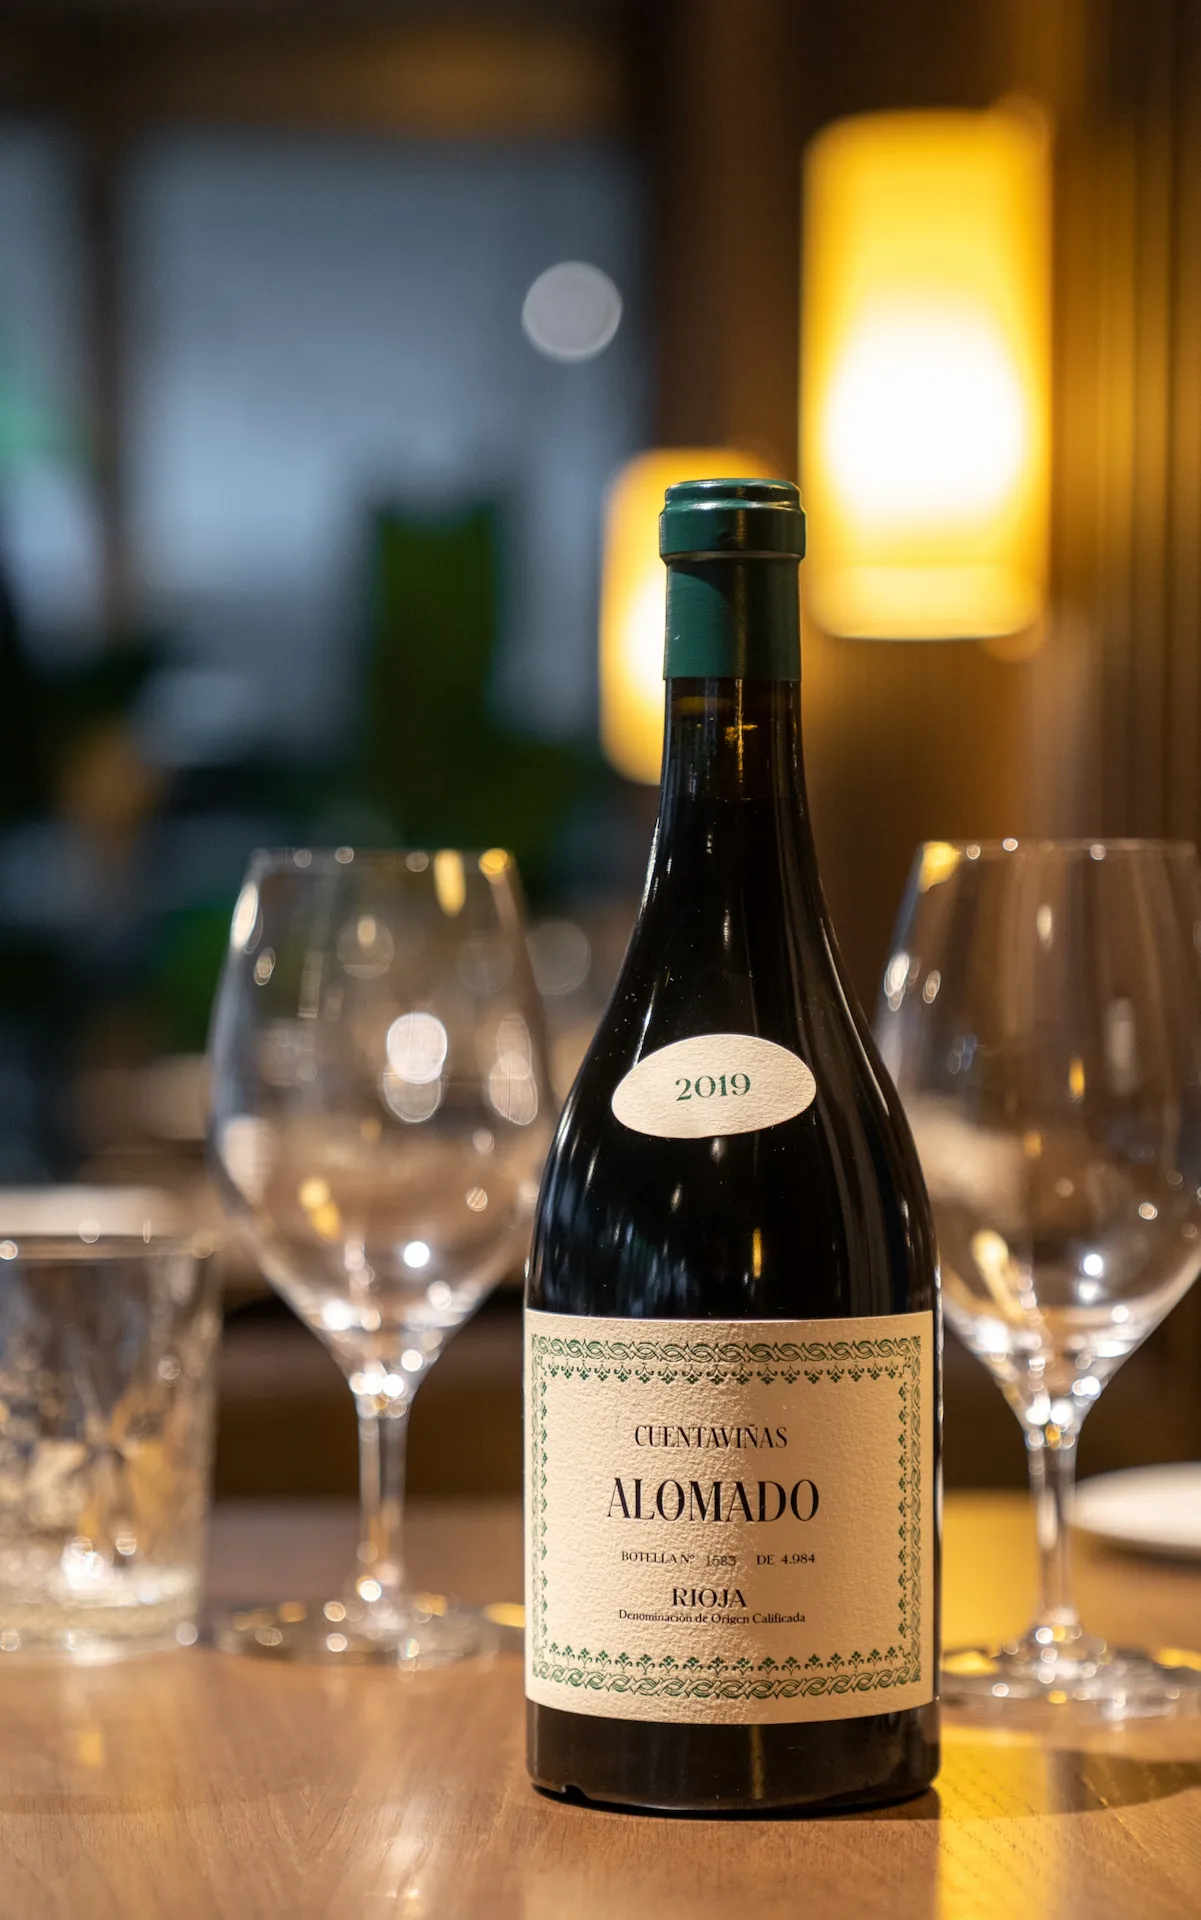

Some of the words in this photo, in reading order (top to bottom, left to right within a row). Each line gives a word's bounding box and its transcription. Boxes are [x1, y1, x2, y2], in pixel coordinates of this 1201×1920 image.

[675, 1073, 751, 1101] 2019
[635, 1424, 788, 1449] CUENTAVIÑAS
[607, 1477, 820, 1523] ALOMADO
[621, 1550, 678, 1565] BOTELLA
[756, 1554, 775, 1566] DE
[781, 1553, 816, 1565] 4.984
[672, 1587, 748, 1609] RIOJA
[619, 1609, 692, 1623] Denominación
[694, 1613, 709, 1624] de
[711, 1613, 750, 1626] Origen
[752, 1612, 806, 1625] Calificada
